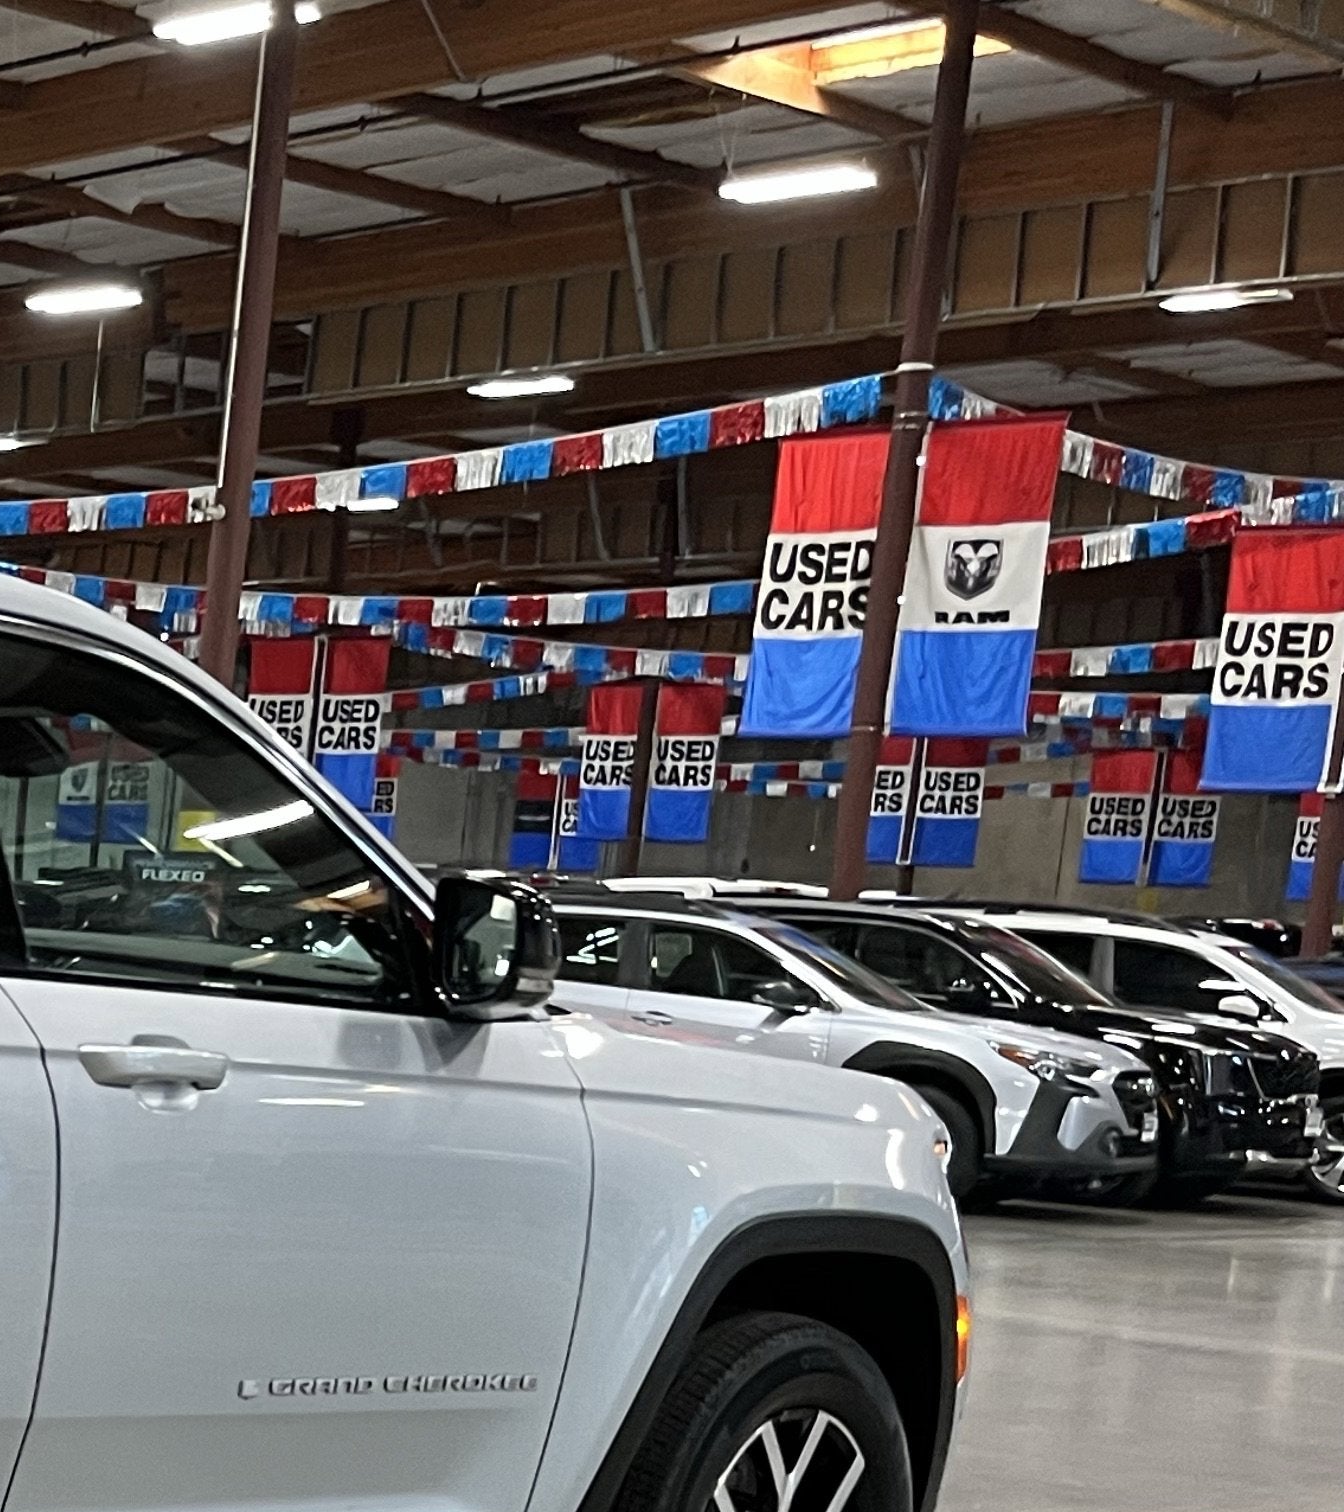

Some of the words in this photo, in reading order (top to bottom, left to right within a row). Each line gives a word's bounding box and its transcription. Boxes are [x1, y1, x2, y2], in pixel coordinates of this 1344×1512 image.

[769, 540, 876, 585] USED
[762, 586, 869, 631] CARS
[934, 610, 1010, 624] RAM
[1224, 621, 1334, 658] USED
[1220, 661, 1329, 699] CARS
[322, 699, 380, 724] USED
[318, 725, 377, 750] CARS
[585, 740, 636, 761] USED
[657, 740, 715, 762] USED
[655, 765, 712, 786] CARS
[876, 770, 905, 790] ED
[924, 771, 981, 792] USED
[376, 781, 394, 796] ED
[374, 797, 393, 813] RS
[873, 793, 902, 813] RS
[919, 794, 979, 815] CARS
[1089, 797, 1146, 816] USED
[1161, 799, 1217, 818] USED
[1086, 818, 1143, 837] CARS
[1158, 819, 1214, 839] CARS
[268, 1377, 375, 1396] GRAND
[383, 1374, 538, 1393] CHEROKEE
